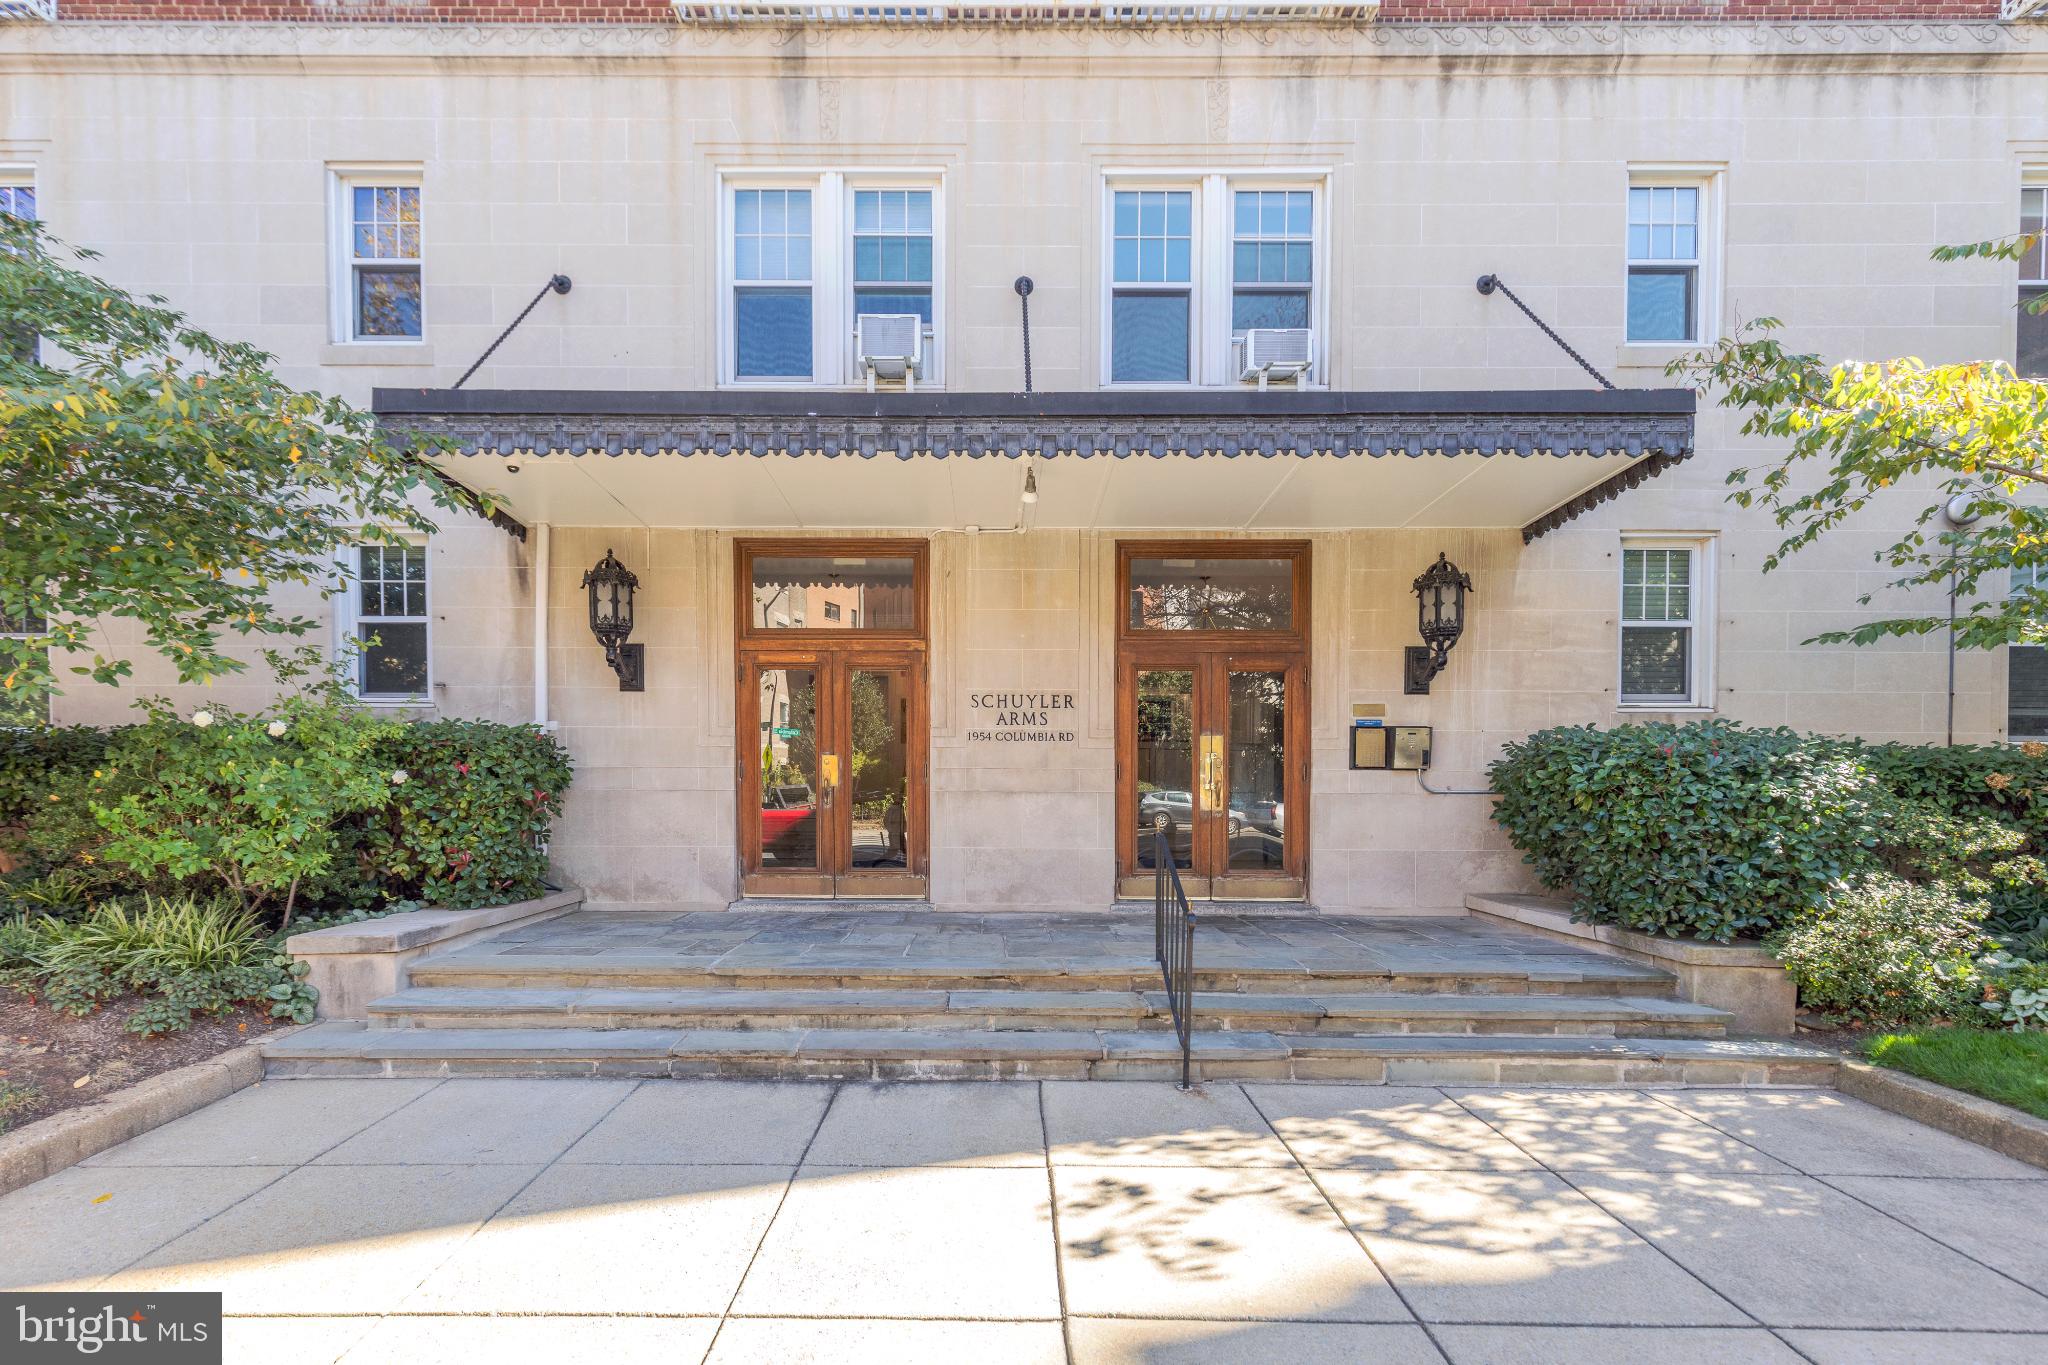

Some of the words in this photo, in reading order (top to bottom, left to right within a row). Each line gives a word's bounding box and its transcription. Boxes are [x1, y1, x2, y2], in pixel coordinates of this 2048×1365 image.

[971, 694, 1075, 709] SCHUYLER
[996, 711, 1048, 726] ARMS
[967, 731, 992, 741] 1954
[995, 731, 1056, 742] COLUMBIA
[1058, 732, 1075, 742] RD
